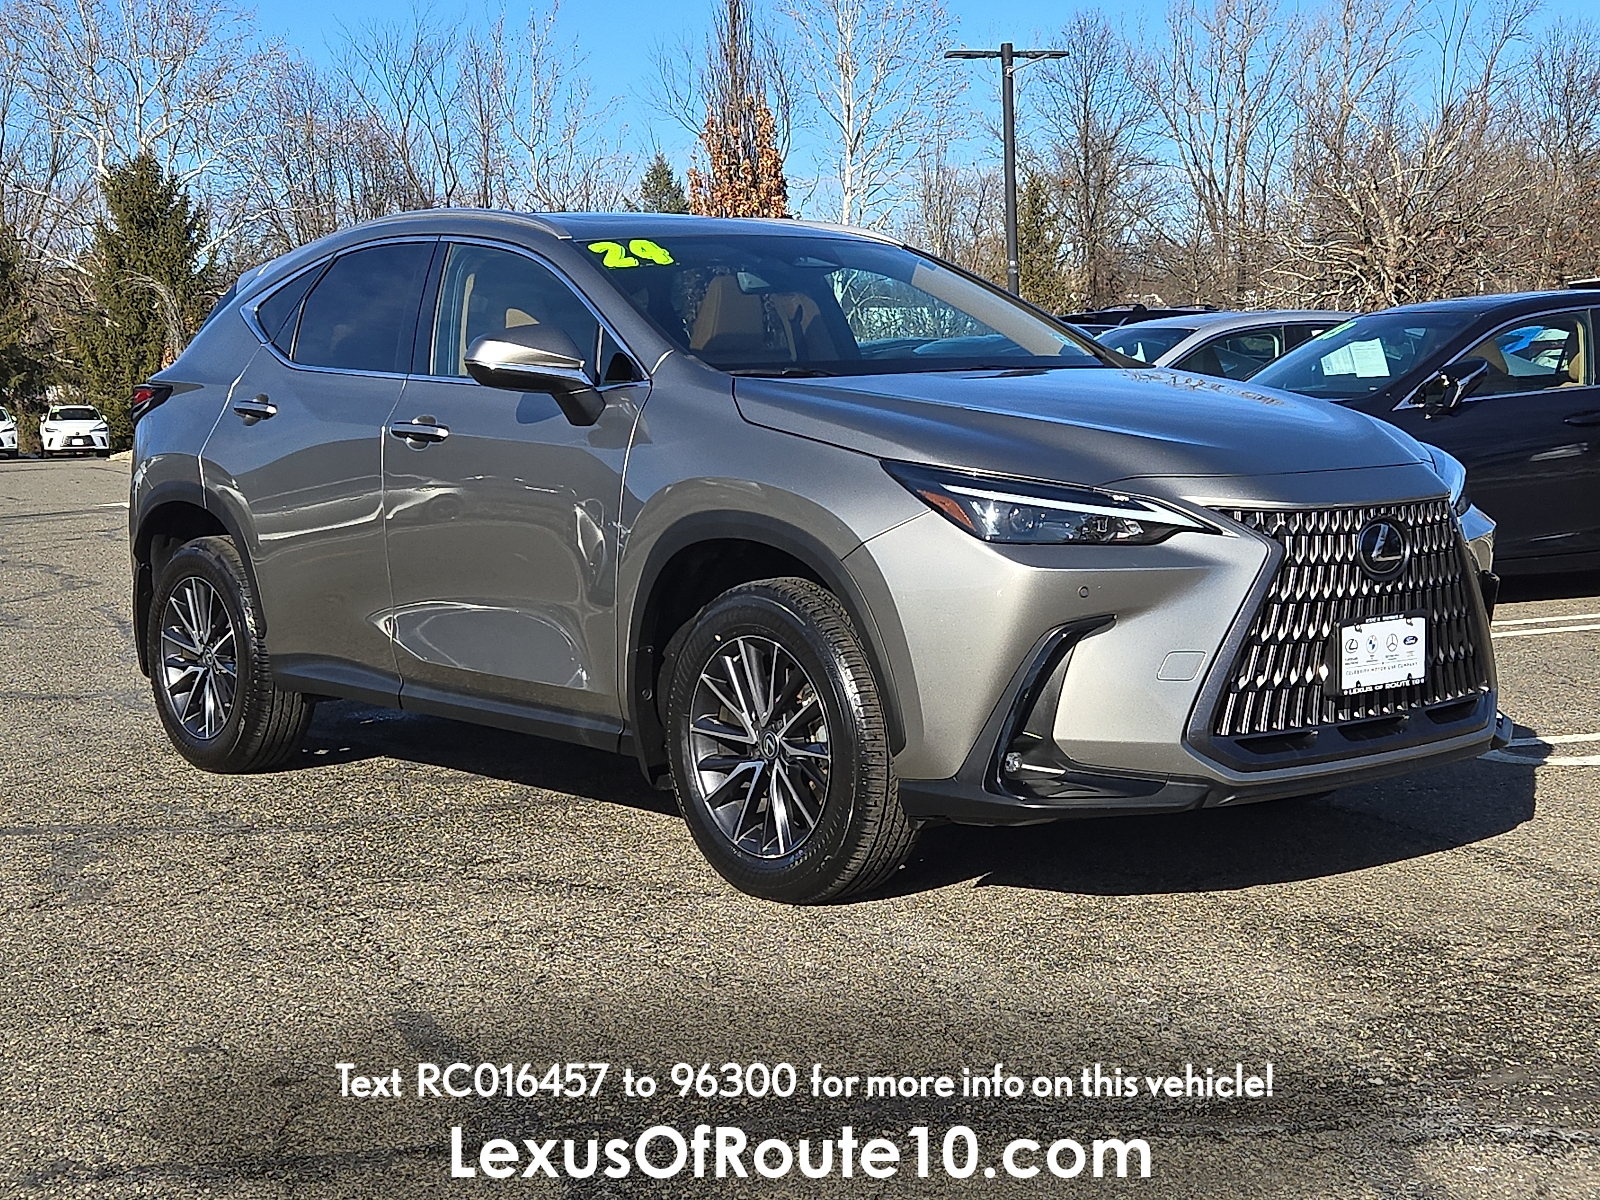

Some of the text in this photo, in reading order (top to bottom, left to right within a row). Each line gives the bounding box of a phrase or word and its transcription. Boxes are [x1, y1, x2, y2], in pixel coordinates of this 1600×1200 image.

[588, 239, 674, 268] 24
[1349, 686, 1373, 695] LEXUS
[1385, 680, 1410, 689] ROUTE
